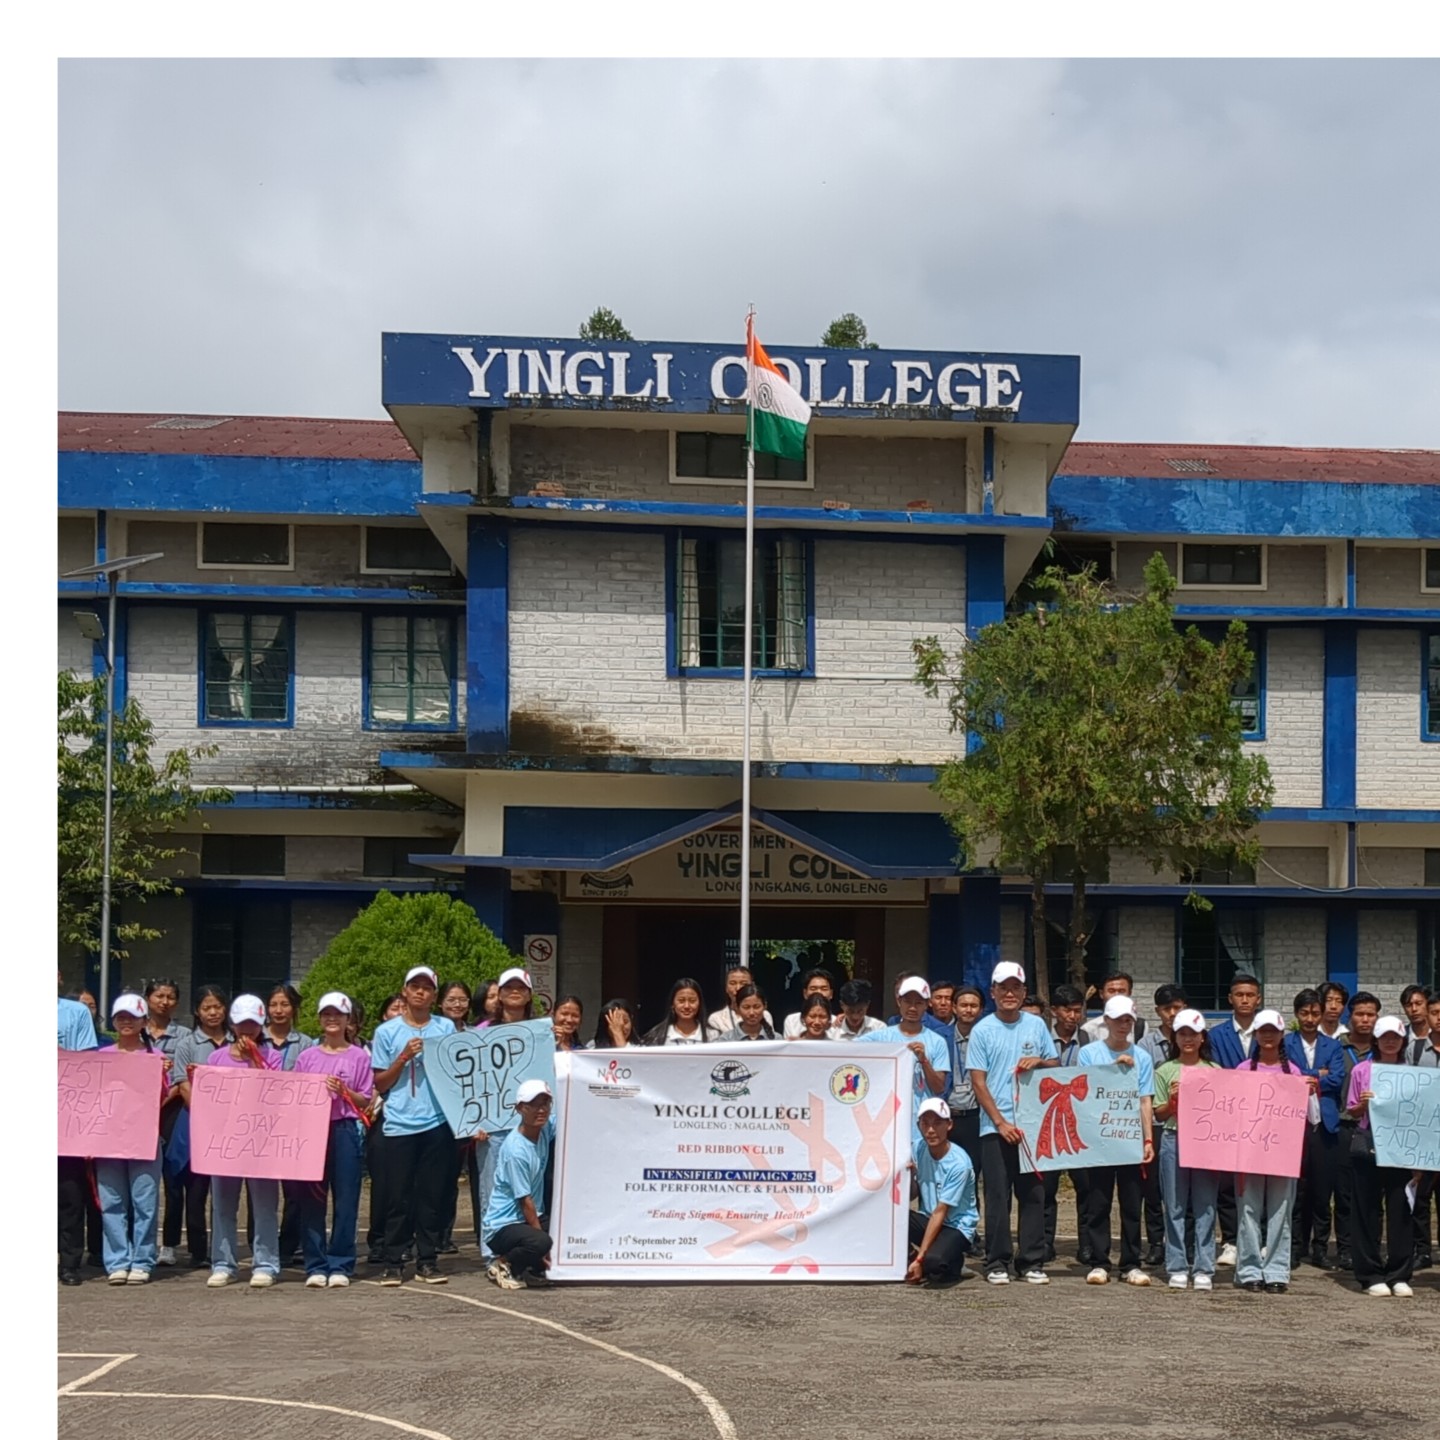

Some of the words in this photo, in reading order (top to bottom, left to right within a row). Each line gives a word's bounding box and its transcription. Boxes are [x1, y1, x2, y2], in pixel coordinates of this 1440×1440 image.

[451, 346, 673, 403] YINGLI
[816, 881, 888, 894] LONGLENG
[454, 1037, 525, 1079] STOP
[198, 1071, 251, 1106] GET
[255, 1076, 330, 1107] TESTED
[461, 1067, 509, 1099] HIV
[1377, 1070, 1432, 1102] STOP
[58, 1087, 124, 1116] REAT
[463, 1088, 518, 1125] STIG
[1123, 1099, 1133, 1111] A
[653, 1104, 718, 1119] YINGLI
[723, 1105, 811, 1120] COLLEGE
[234, 1112, 285, 1137] STAY
[673, 1120, 727, 1130] LONGLENG
[734, 1122, 790, 1131] NAGALAND
[1099, 1127, 1141, 1140] CHOICE
[1374, 1125, 1421, 1150] END
[203, 1134, 308, 1161] HEALTHY
[677, 1144, 701, 1154] RED
[704, 1144, 750, 1155] RIBBON
[752, 1145, 785, 1155] CLUB
[646, 1169, 723, 1180] INTENSIFIED
[724, 1170, 789, 1181] CAMPAIGN
[790, 1171, 814, 1181] 2025
[625, 1182, 657, 1192] FOLK
[660, 1183, 751, 1193] PERFORMANCE
[753, 1183, 762, 1193] &
[766, 1183, 804, 1194] FLASH
[806, 1184, 834, 1194] MOB
[726, 1210, 769, 1221] Ensuring
[567, 1236, 588, 1245] Date
[631, 1235, 676, 1247] September
[678, 1236, 698, 1245] 2025
[566, 1251, 604, 1260] Location
[614, 1251, 673, 1261] LONGLENG
